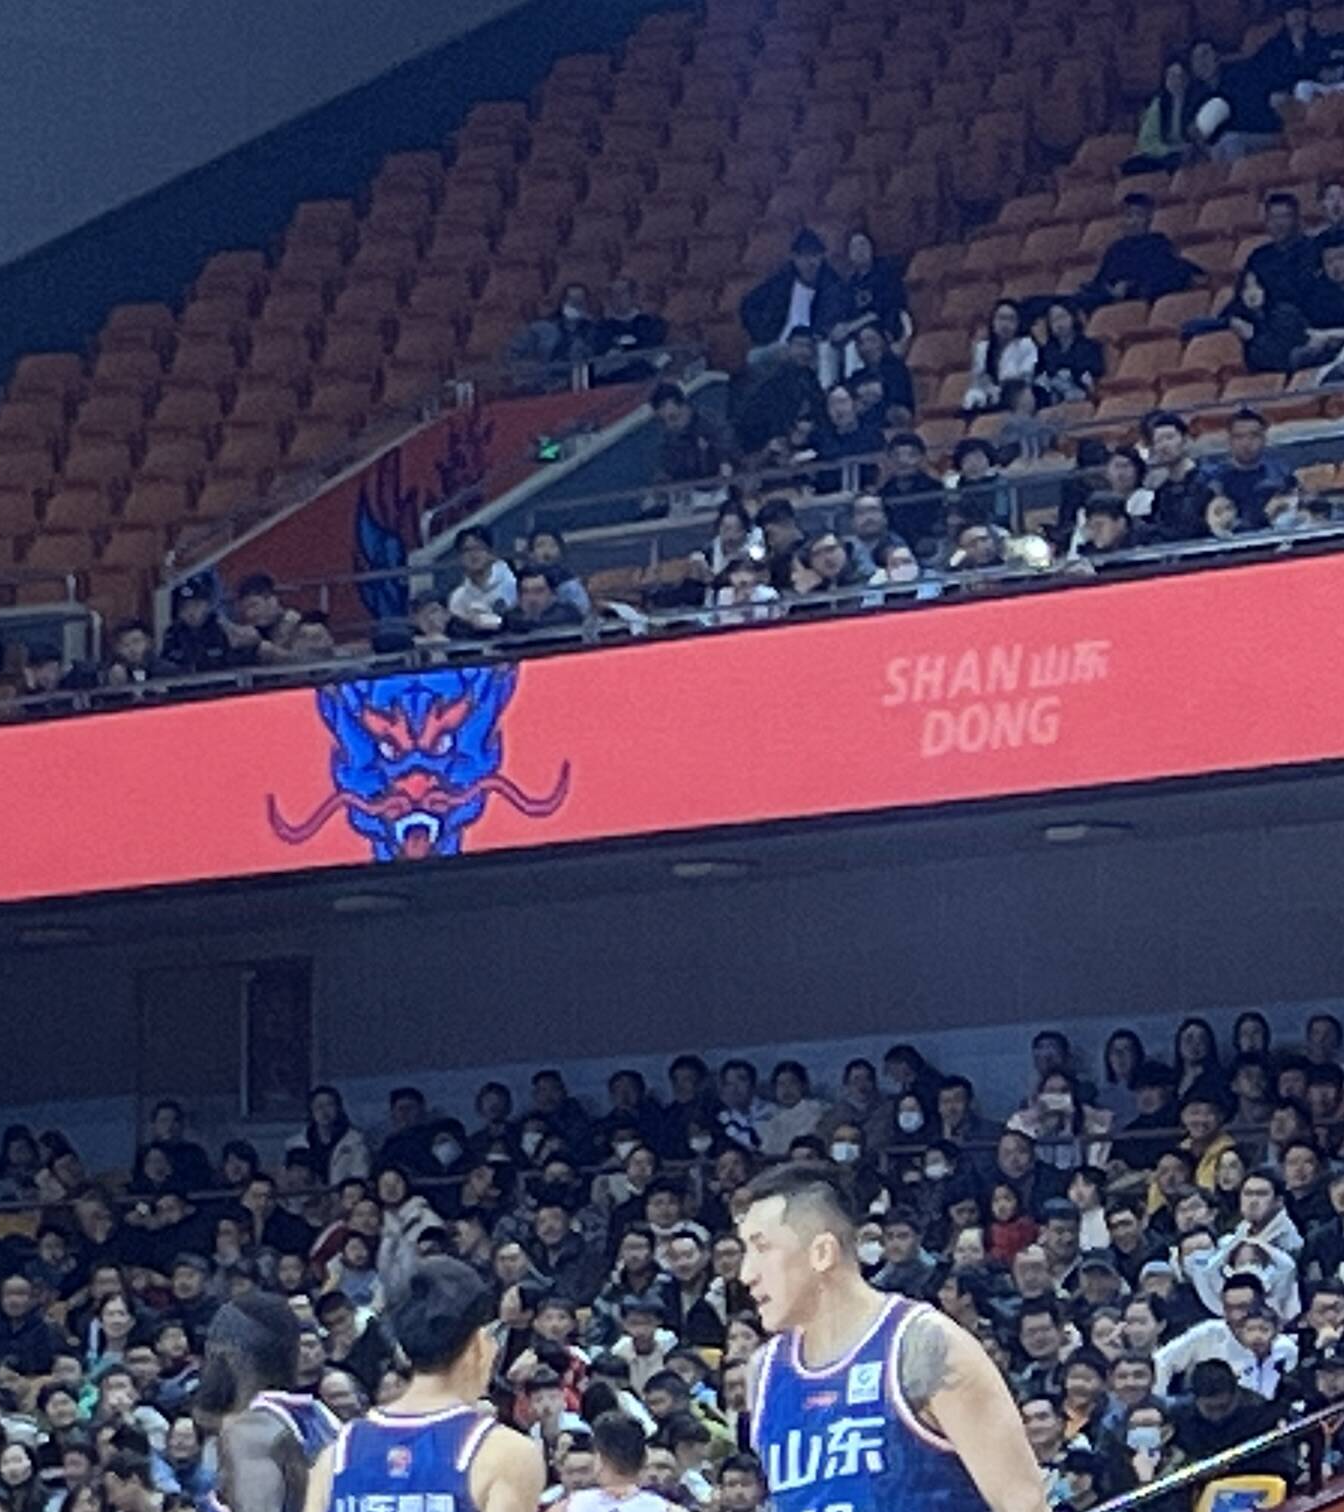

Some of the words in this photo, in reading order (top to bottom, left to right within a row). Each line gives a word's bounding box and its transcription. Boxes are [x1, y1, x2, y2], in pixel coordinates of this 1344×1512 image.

[881, 643, 1024, 707] SHAN
[1028, 638, 1112, 688] 山东
[920, 696, 1063, 758] DONG
[770, 1416, 886, 1493] 山东
